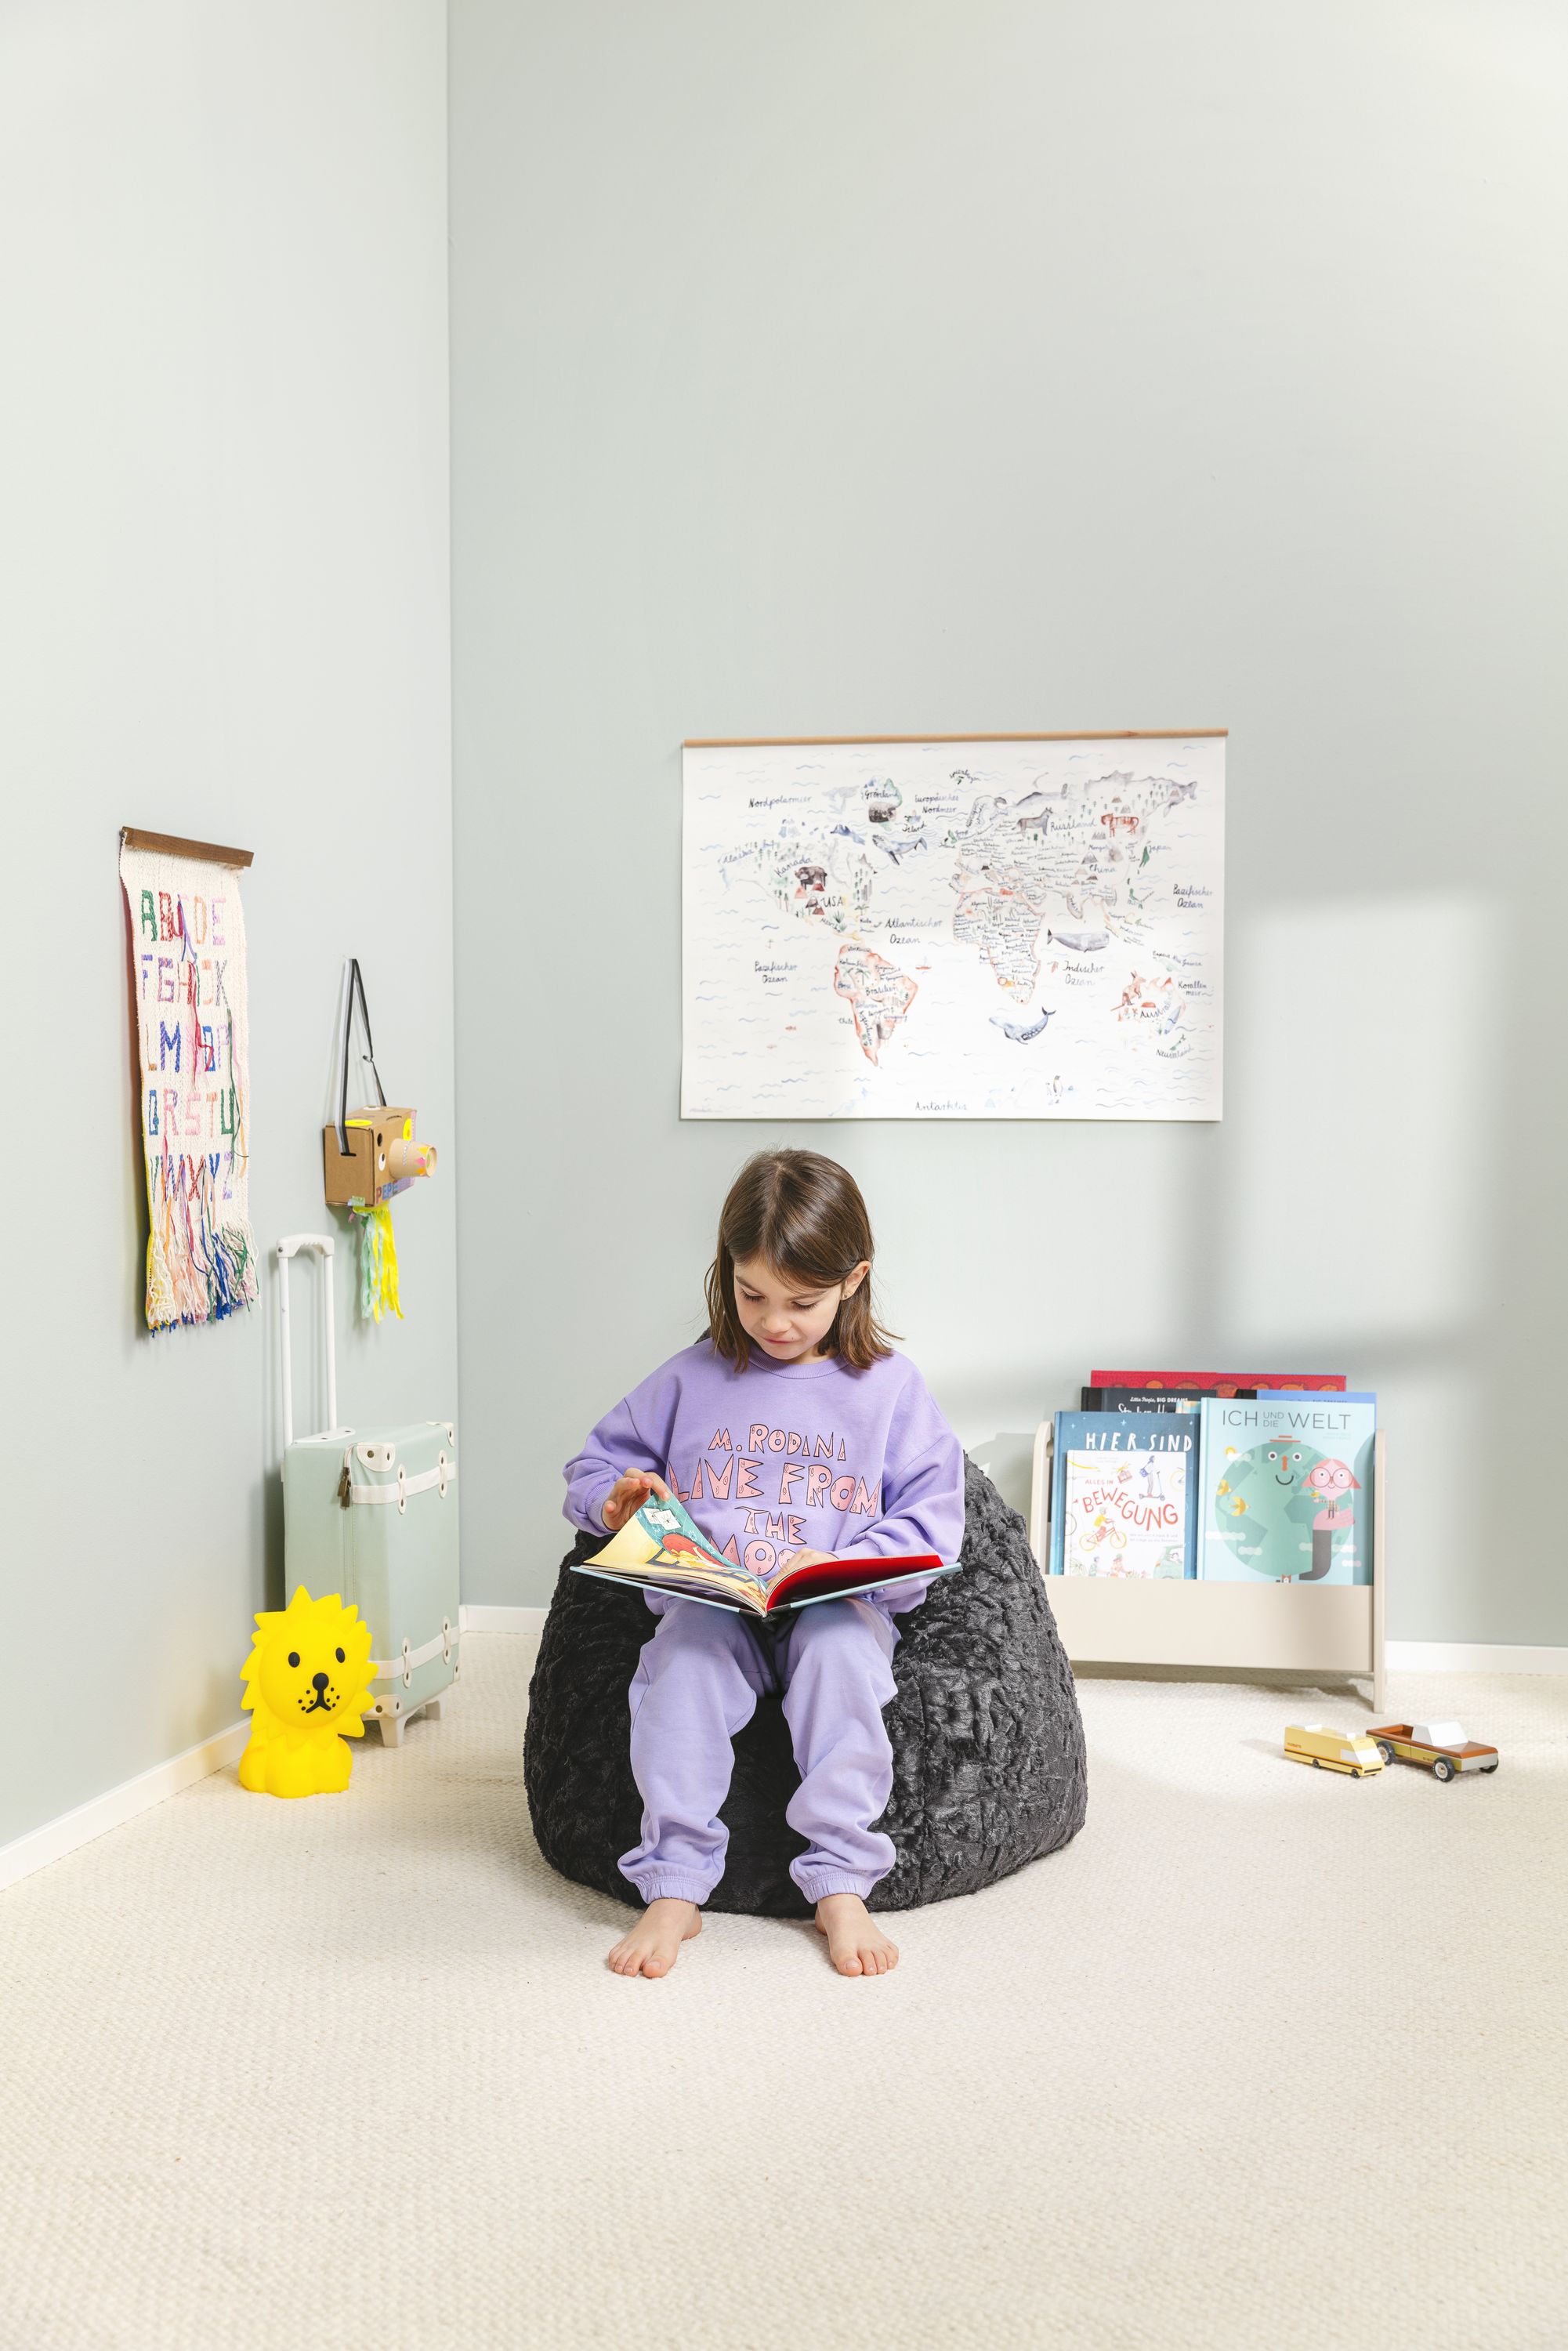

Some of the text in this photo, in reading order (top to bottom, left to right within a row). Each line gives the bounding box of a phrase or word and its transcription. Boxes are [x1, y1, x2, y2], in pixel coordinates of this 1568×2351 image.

[1050, 817, 1099, 832] Russland
[774, 855, 813, 878] Kanada
[1089, 864, 1117, 875] China
[1173, 883, 1213, 898] Pazifischer
[821, 896, 844, 907] USA
[1177, 897, 1204, 909] Ozean
[884, 917, 943, 929] Atlantischer
[889, 933, 921, 944] Ozean
[1062, 960, 1105, 973] Indischer
[762, 974, 788, 984] Ozean
[1178, 980, 1208, 990] Korallen
[1222, 1410, 1258, 1427] ICH
[1288, 1412, 1352, 1430] WELT
[1262, 1419, 1280, 1428] DIE
[748, 1423, 846, 1462] RODINI
[1085, 1433, 1193, 1452] HIER SIND
[668, 1454, 882, 1518] LIVE FROM
[1082, 1487, 1179, 1531] BEWEGUNG
[734, 1505, 808, 1545] THE
